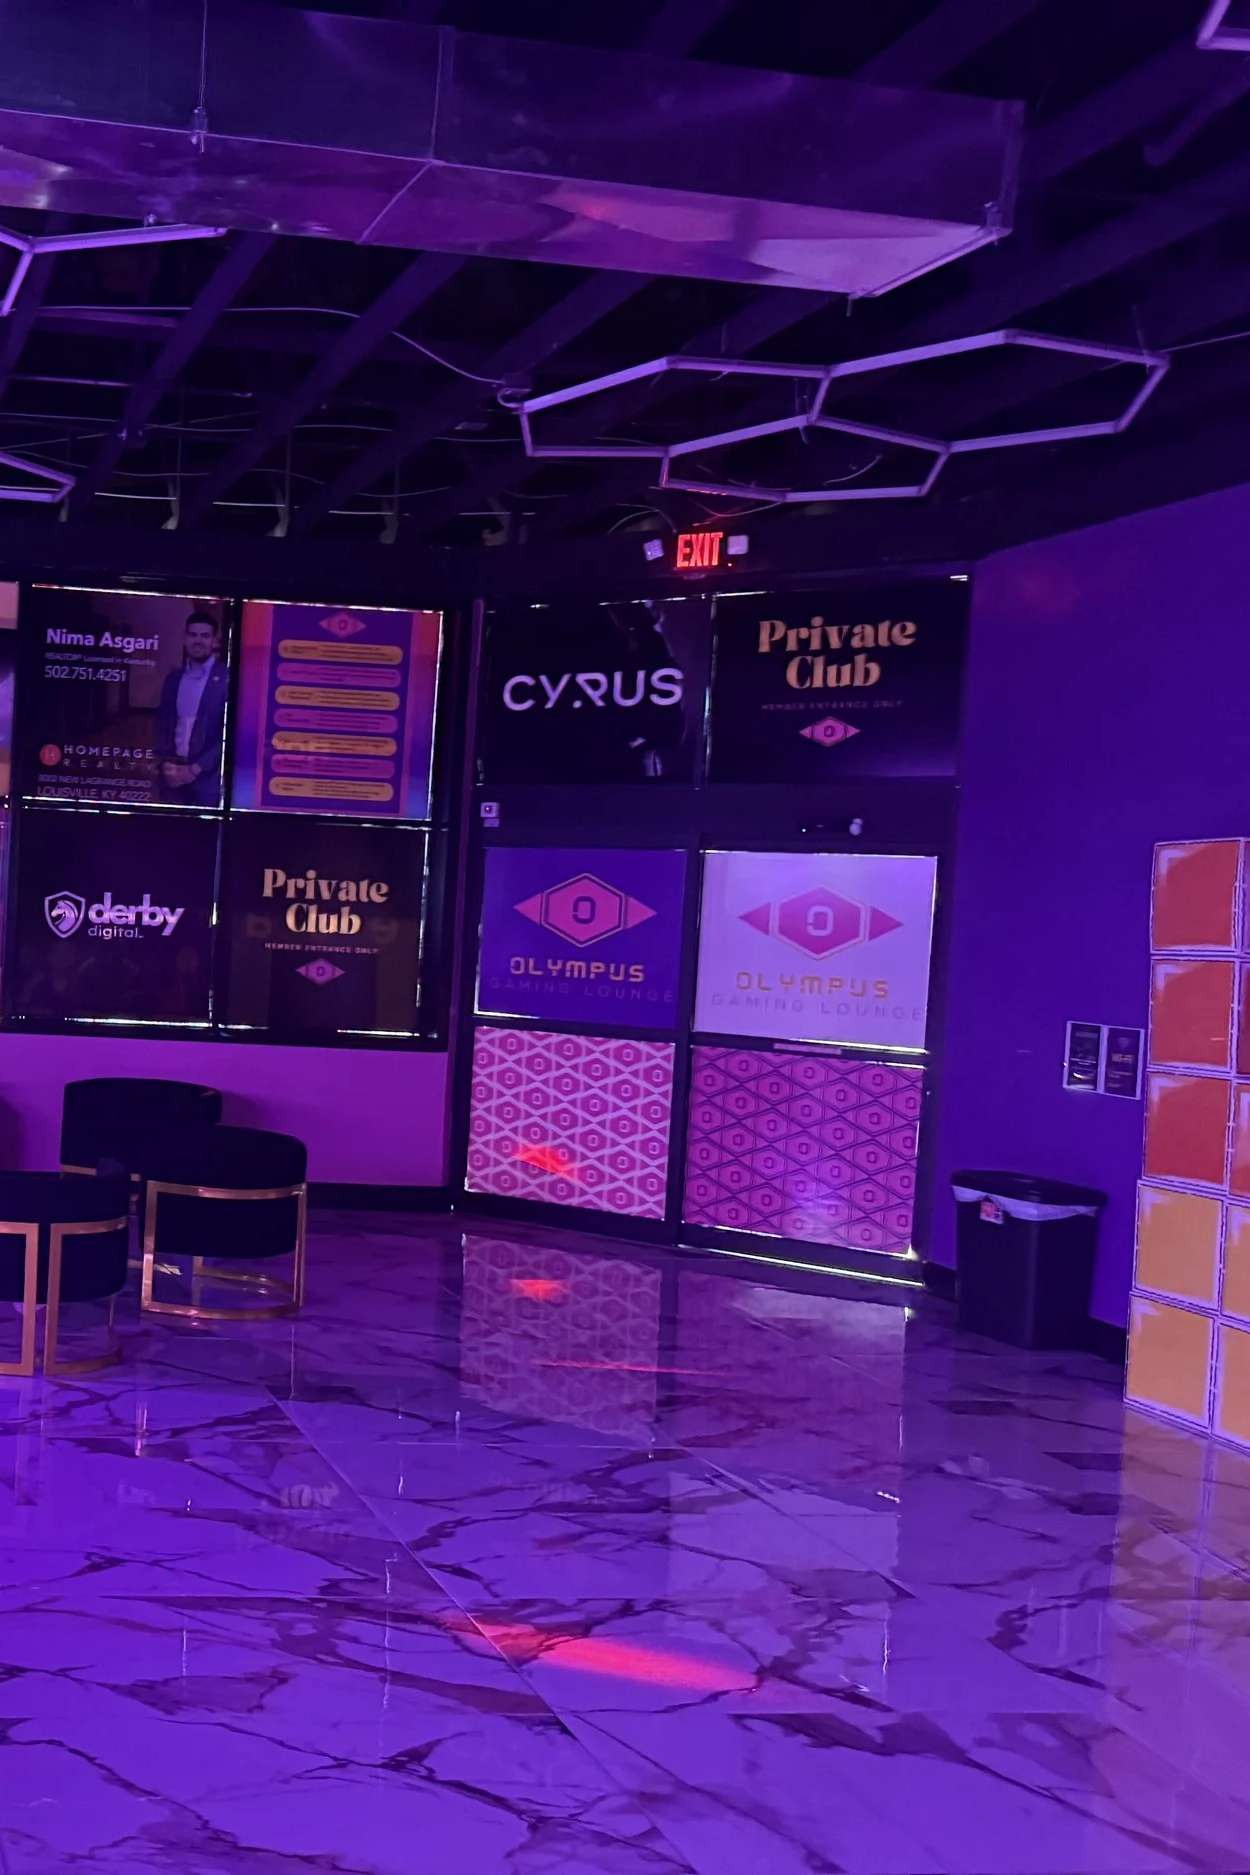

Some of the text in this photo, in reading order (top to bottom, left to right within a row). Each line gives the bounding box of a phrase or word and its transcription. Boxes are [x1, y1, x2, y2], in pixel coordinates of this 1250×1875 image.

[677, 532, 723, 567] EXIT
[46, 628, 159, 653] Nima Asgari
[758, 616, 918, 653] Private
[44, 665, 126, 681] 502.751.4251
[786, 653, 881, 689] Club
[503, 667, 684, 711] CYRUS
[64, 744, 153, 759] HOMEPAGE
[262, 868, 389, 903] Private
[88, 892, 186, 936] derby
[286, 903, 361, 935] Club
[510, 956, 644, 982] OLYMPUS
[489, 977, 675, 1002] GAMING LOUNGE
[736, 971, 889, 999] OLYMPUS
[711, 993, 926, 1021] GAMING LOUNGE
